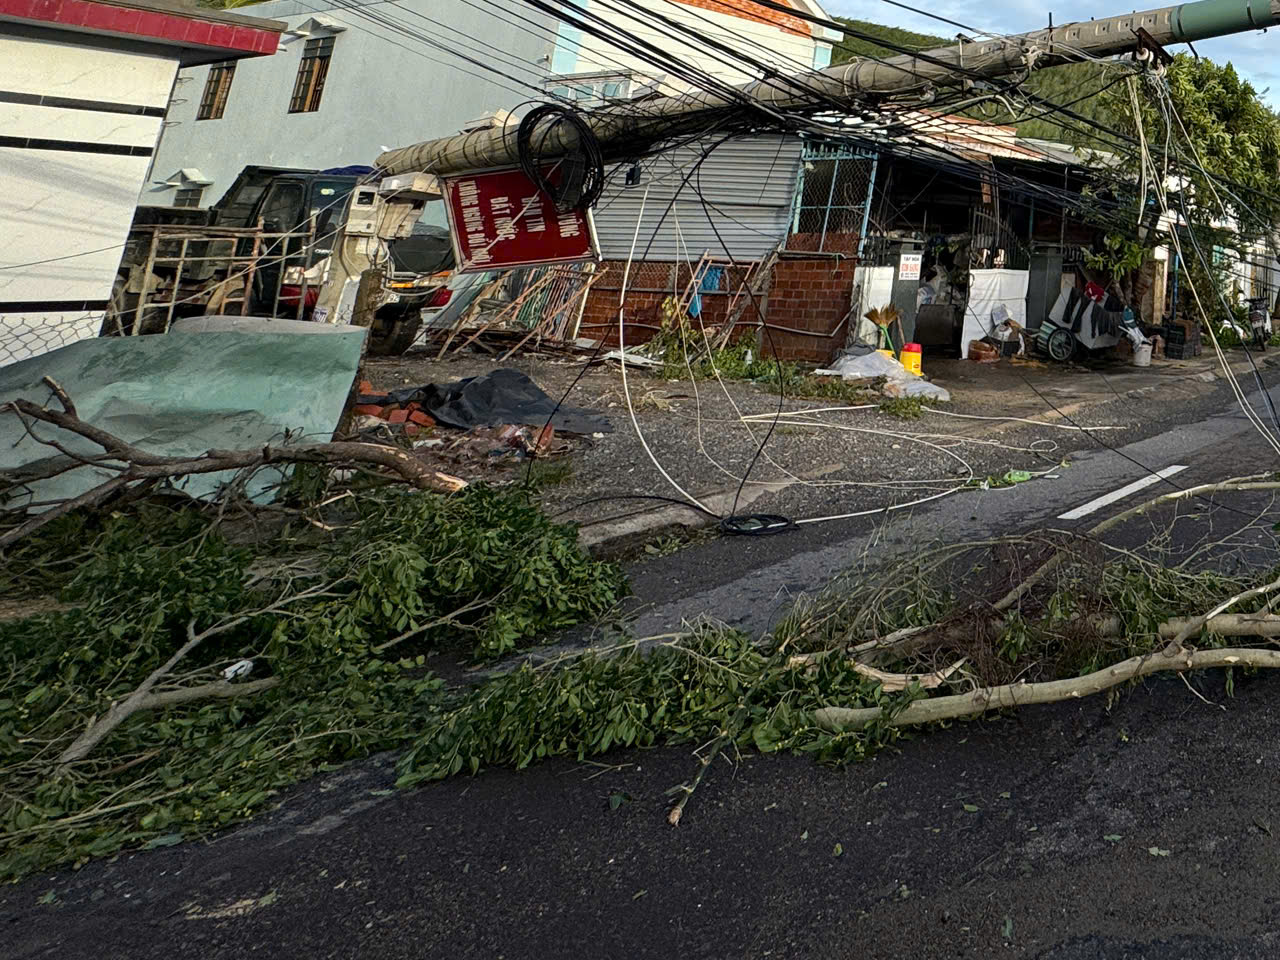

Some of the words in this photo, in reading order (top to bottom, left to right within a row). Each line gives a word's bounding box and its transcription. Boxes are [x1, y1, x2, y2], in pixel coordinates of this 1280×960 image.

[458, 180, 481, 206] KHÔNG
[490, 196, 515, 215] ĐẤT
[462, 206, 485, 232] NGỪNG
[494, 217, 520, 241] NƯỚC
[525, 217, 546, 232] TIN
[467, 232, 492, 248] ĐỔI
